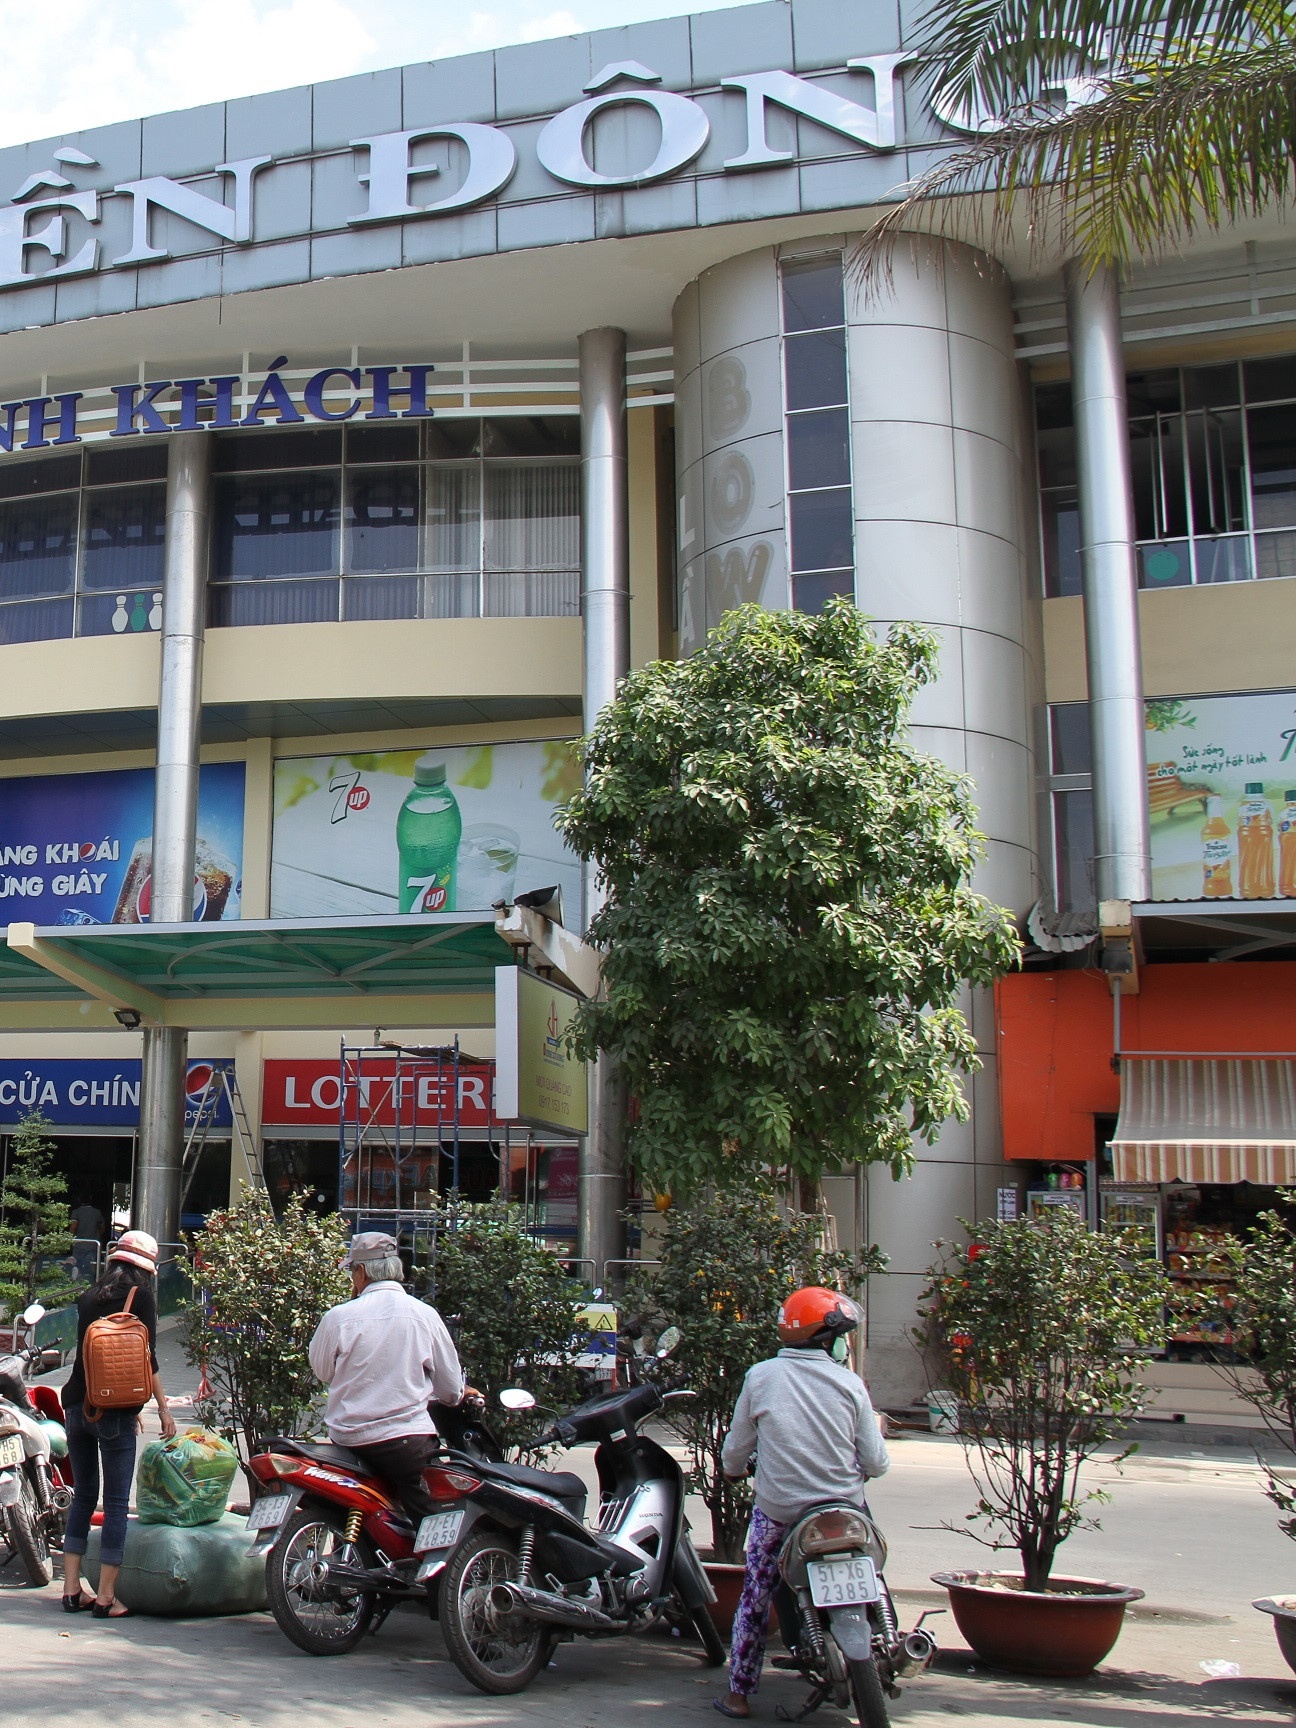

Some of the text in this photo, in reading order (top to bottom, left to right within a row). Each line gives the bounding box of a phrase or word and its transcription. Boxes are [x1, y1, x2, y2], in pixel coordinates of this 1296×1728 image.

[109, 356, 434, 436] KHÁCH
[1157, 764, 1175, 777] cho
[1201, 759, 1223, 773] ngày
[1225, 754, 1244, 768] tốt
[1246, 752, 1267, 765] lành
[328, 771, 370, 824] 7up
[52, 868, 108, 896] GIÂY
[68, 1074, 141, 1106] CHÍN
[285, 1075, 496, 1110] LOTTER
[425, 1513, 456, 1533] 77-E1
[817, 1562, 864, 1582] 51-X6
[821, 1581, 869, 1603] 2385
